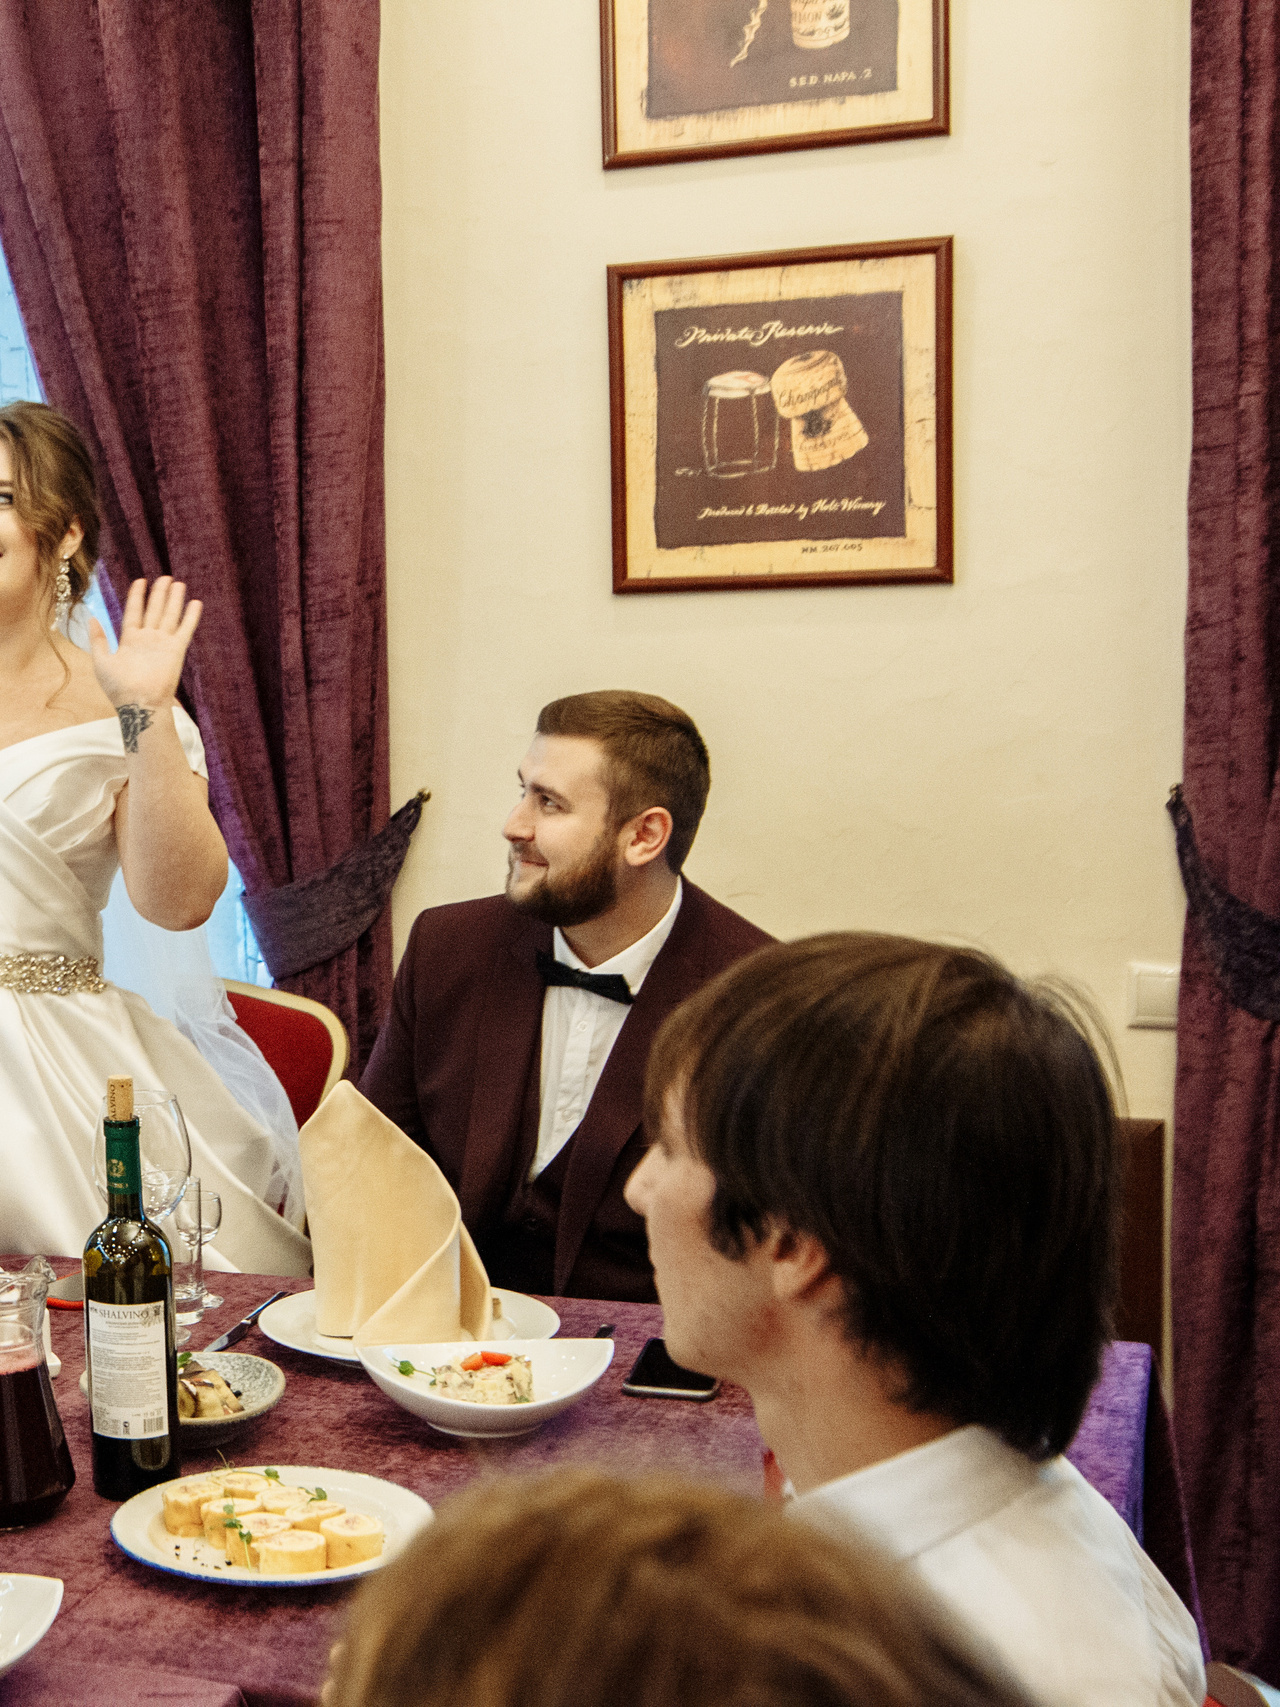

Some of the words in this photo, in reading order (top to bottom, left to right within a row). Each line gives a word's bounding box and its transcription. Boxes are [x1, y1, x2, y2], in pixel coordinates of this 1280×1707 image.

[823, 70, 857, 84] NAPA
[675, 325, 753, 348] Private
[750, 320, 845, 347] Reserve
[696, 505, 746, 520] Produced
[755, 502, 796, 516] Bottled
[795, 503, 809, 521] by
[840, 496, 886, 517] Winery
[109, 1083, 118, 1120] ALVINO
[98, 1308, 150, 1321] SHALVINO
